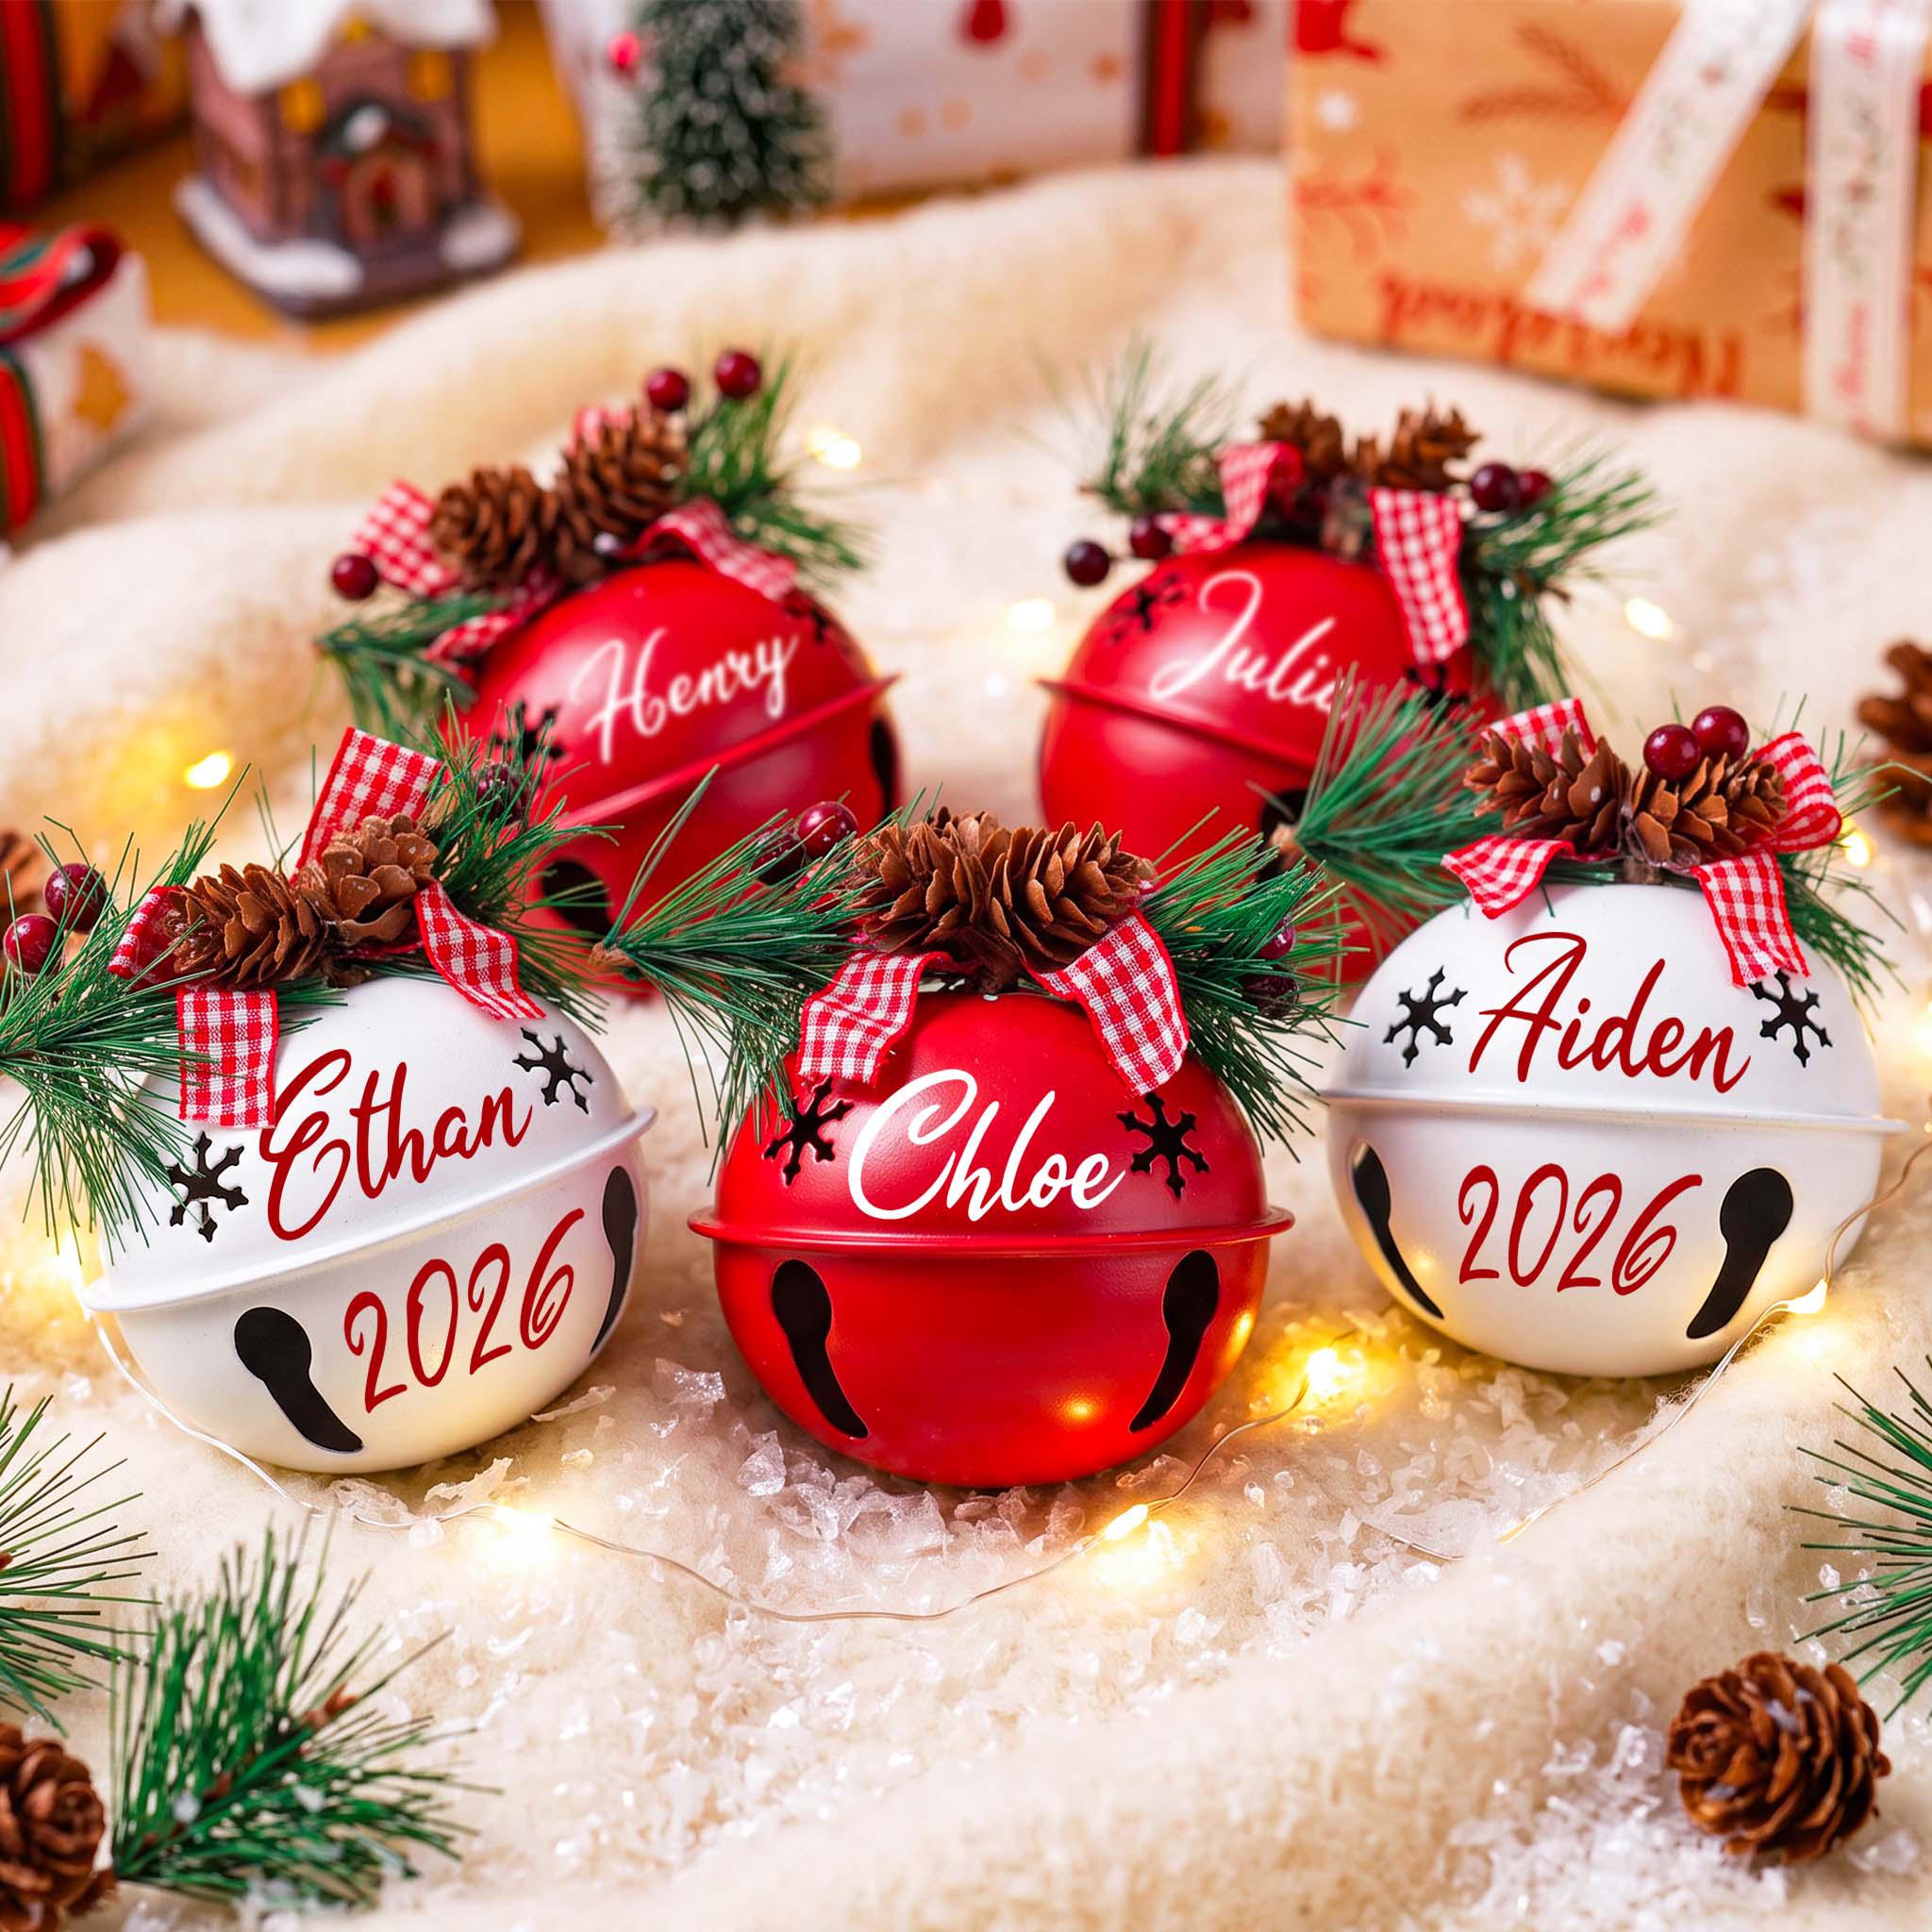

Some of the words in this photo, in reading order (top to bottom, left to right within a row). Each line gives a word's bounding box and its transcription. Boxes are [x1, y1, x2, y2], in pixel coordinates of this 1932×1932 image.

[569, 626, 799, 765] Henry
[1468, 931, 1752, 1094] Aiden
[258, 1048, 533, 1241] Ethan
[848, 1068, 1126, 1223] Chloe
[1457, 1162, 1703, 1296] 2026
[343, 1208, 585, 1414] 2026
